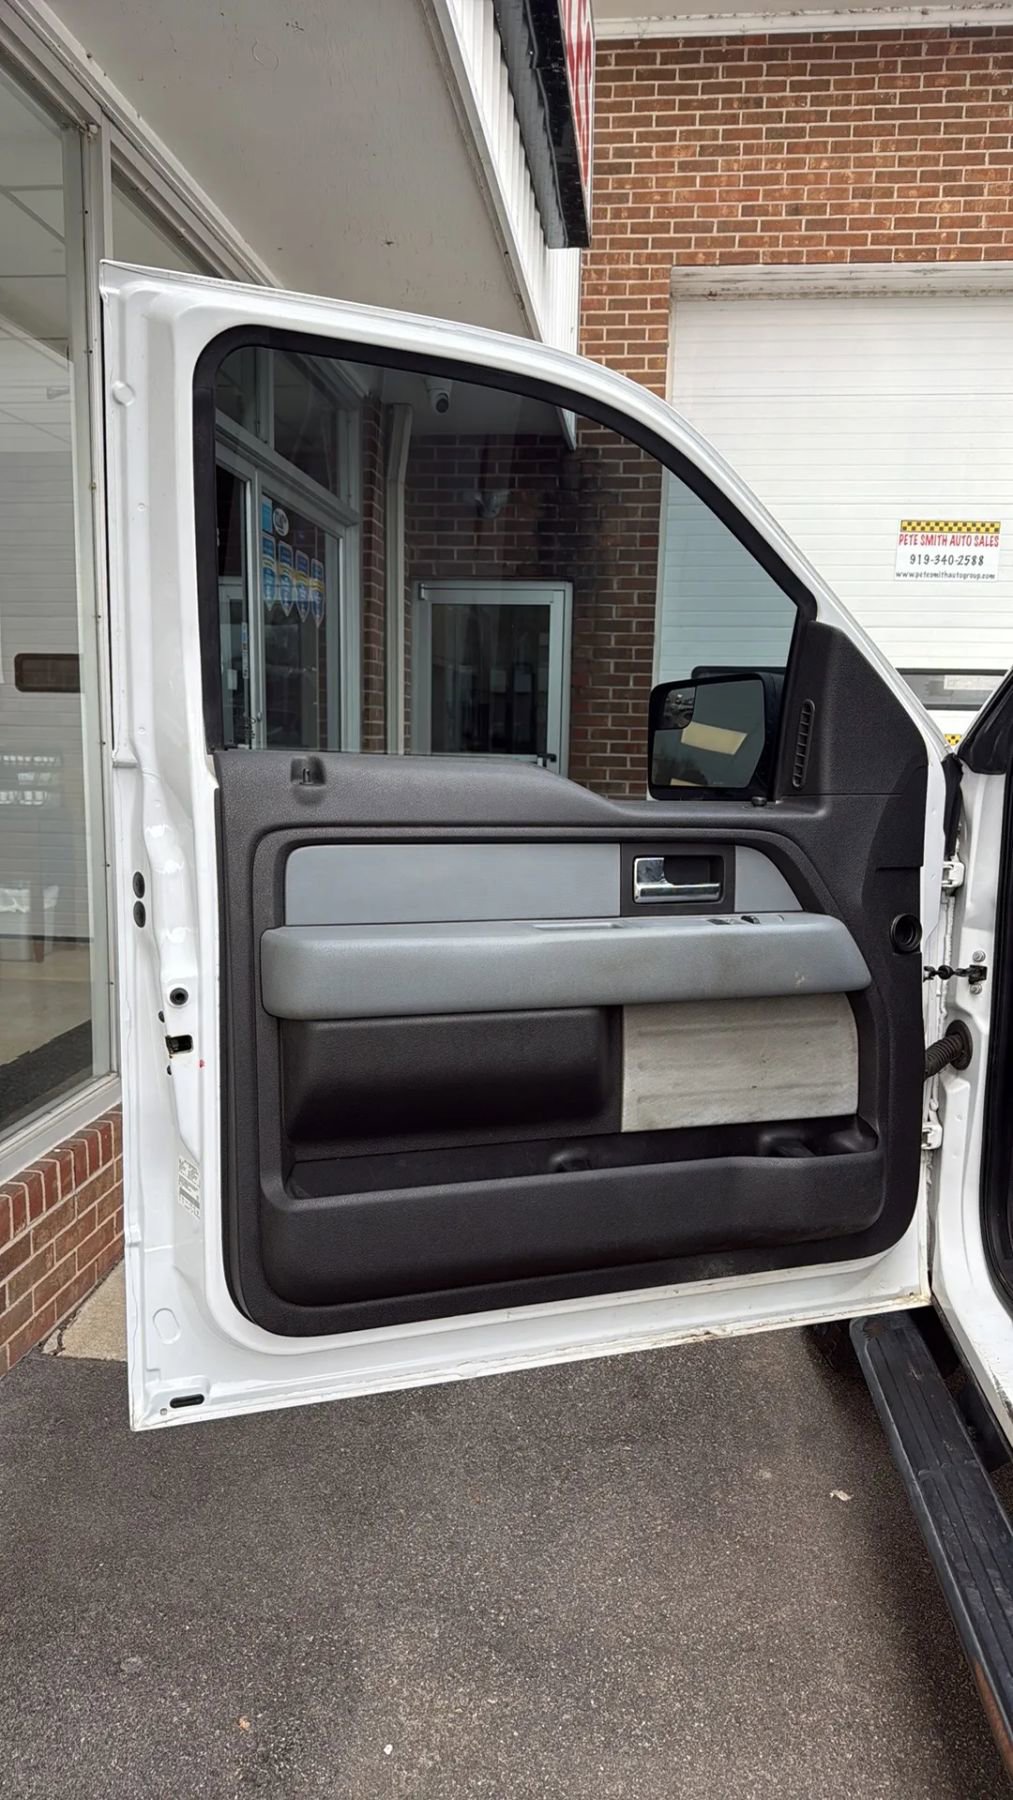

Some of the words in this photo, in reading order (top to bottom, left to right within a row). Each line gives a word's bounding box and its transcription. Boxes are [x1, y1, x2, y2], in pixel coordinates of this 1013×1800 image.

[899, 534, 918, 546] PETE
[920, 534, 948, 547] SMITH
[949, 535, 973, 547] AUTO
[974, 535, 999, 547] SALES
[910, 554, 984, 566] 919-340-2588
